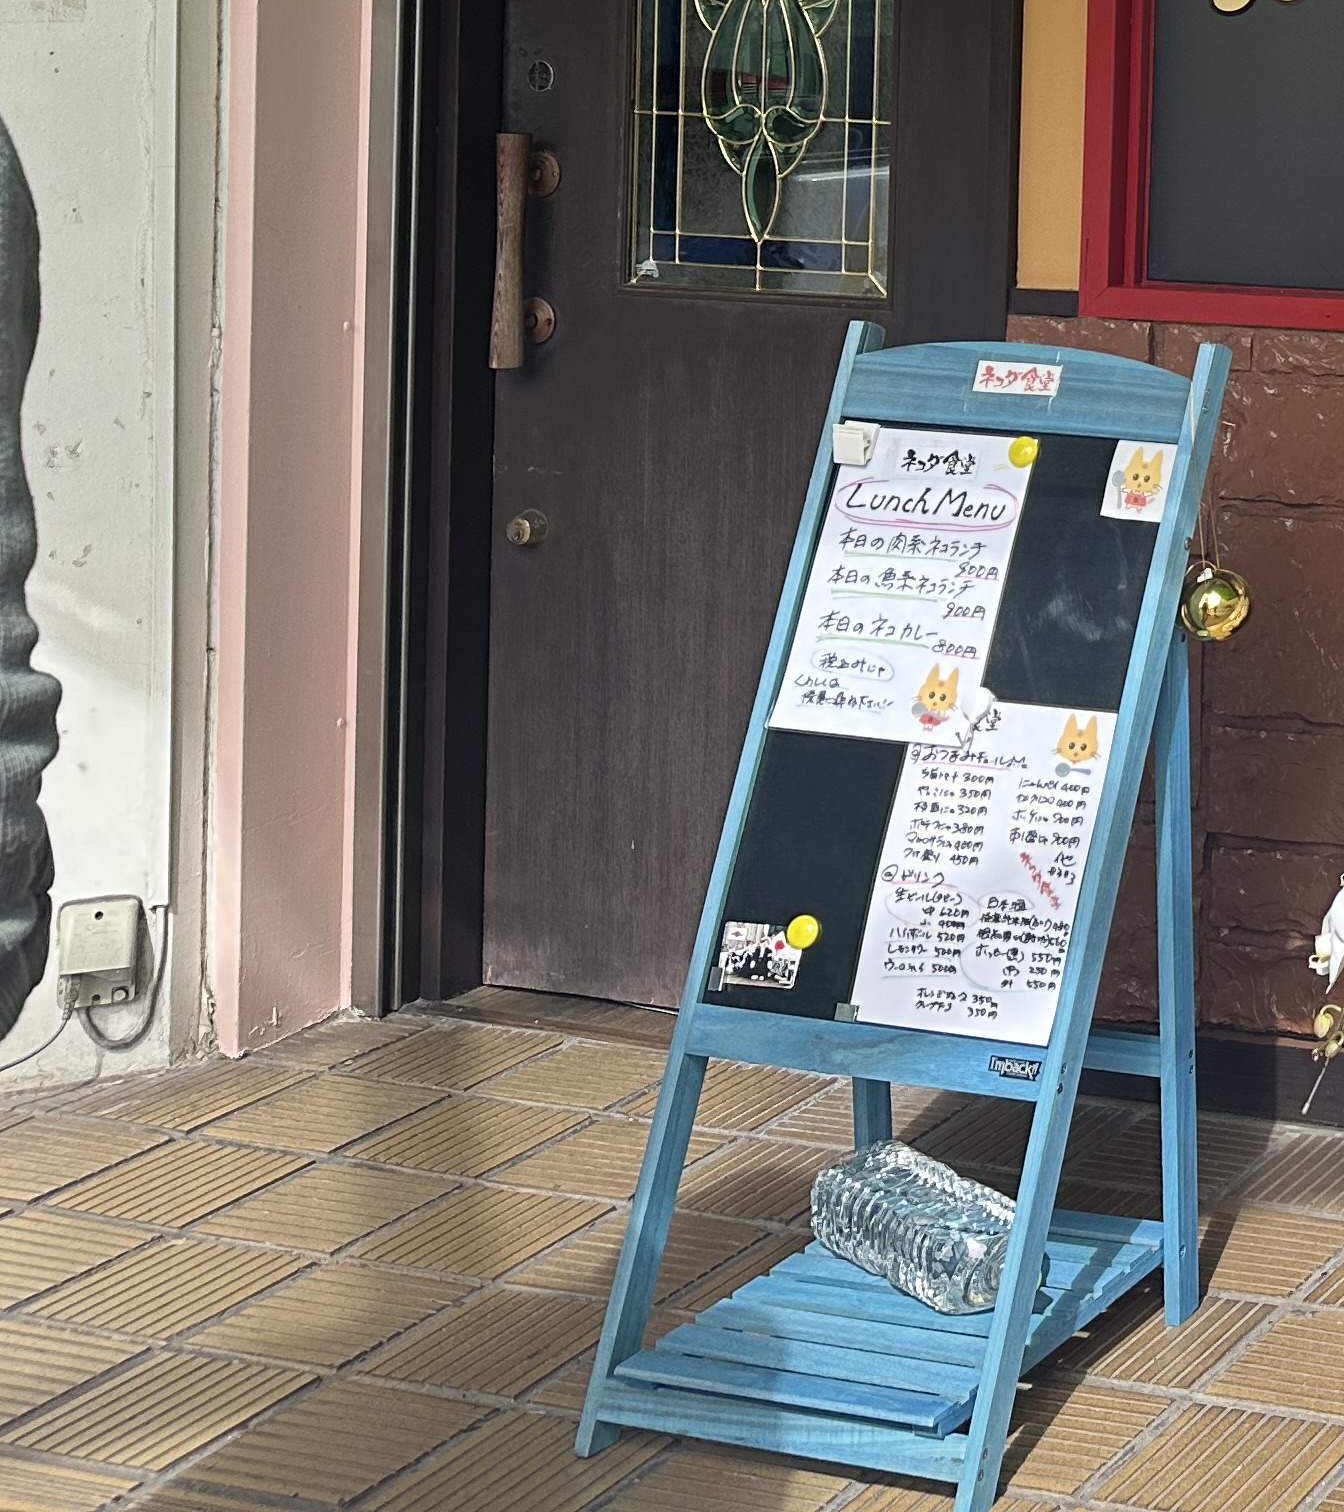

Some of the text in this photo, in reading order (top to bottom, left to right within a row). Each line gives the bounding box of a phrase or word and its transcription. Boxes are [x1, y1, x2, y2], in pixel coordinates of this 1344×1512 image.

[978, 365, 1055, 392] ネコダ食堂
[900, 448, 977, 476] ネコダ食堂
[845, 482, 1007, 521] Lunch Menu
[942, 601, 987, 622] 900円
[931, 639, 978, 659] 800円
